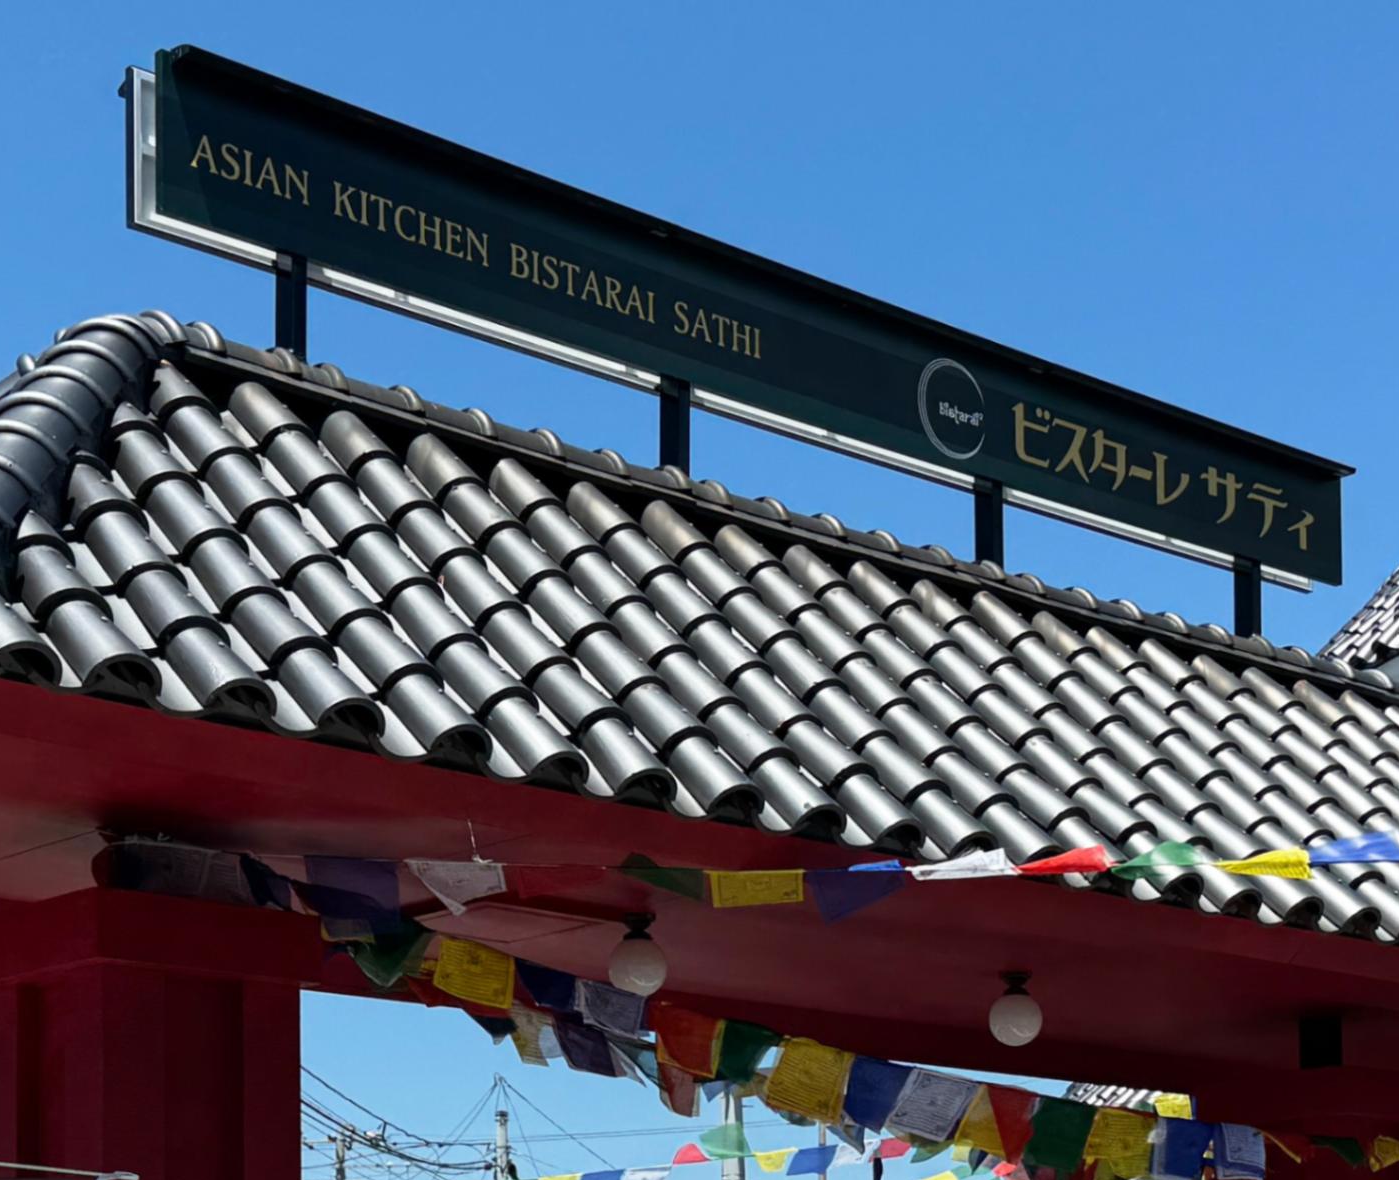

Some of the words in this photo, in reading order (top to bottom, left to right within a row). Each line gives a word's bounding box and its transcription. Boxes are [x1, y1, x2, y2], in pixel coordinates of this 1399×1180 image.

[189, 134, 311, 206] ASIAN
[333, 181, 490, 268] KITCHEN
[510, 242, 657, 324] BISTARAI
[673, 302, 762, 360] SATHI
[1011, 402, 1191, 507] ビスターレ
[1200, 465, 1316, 551] サティ
